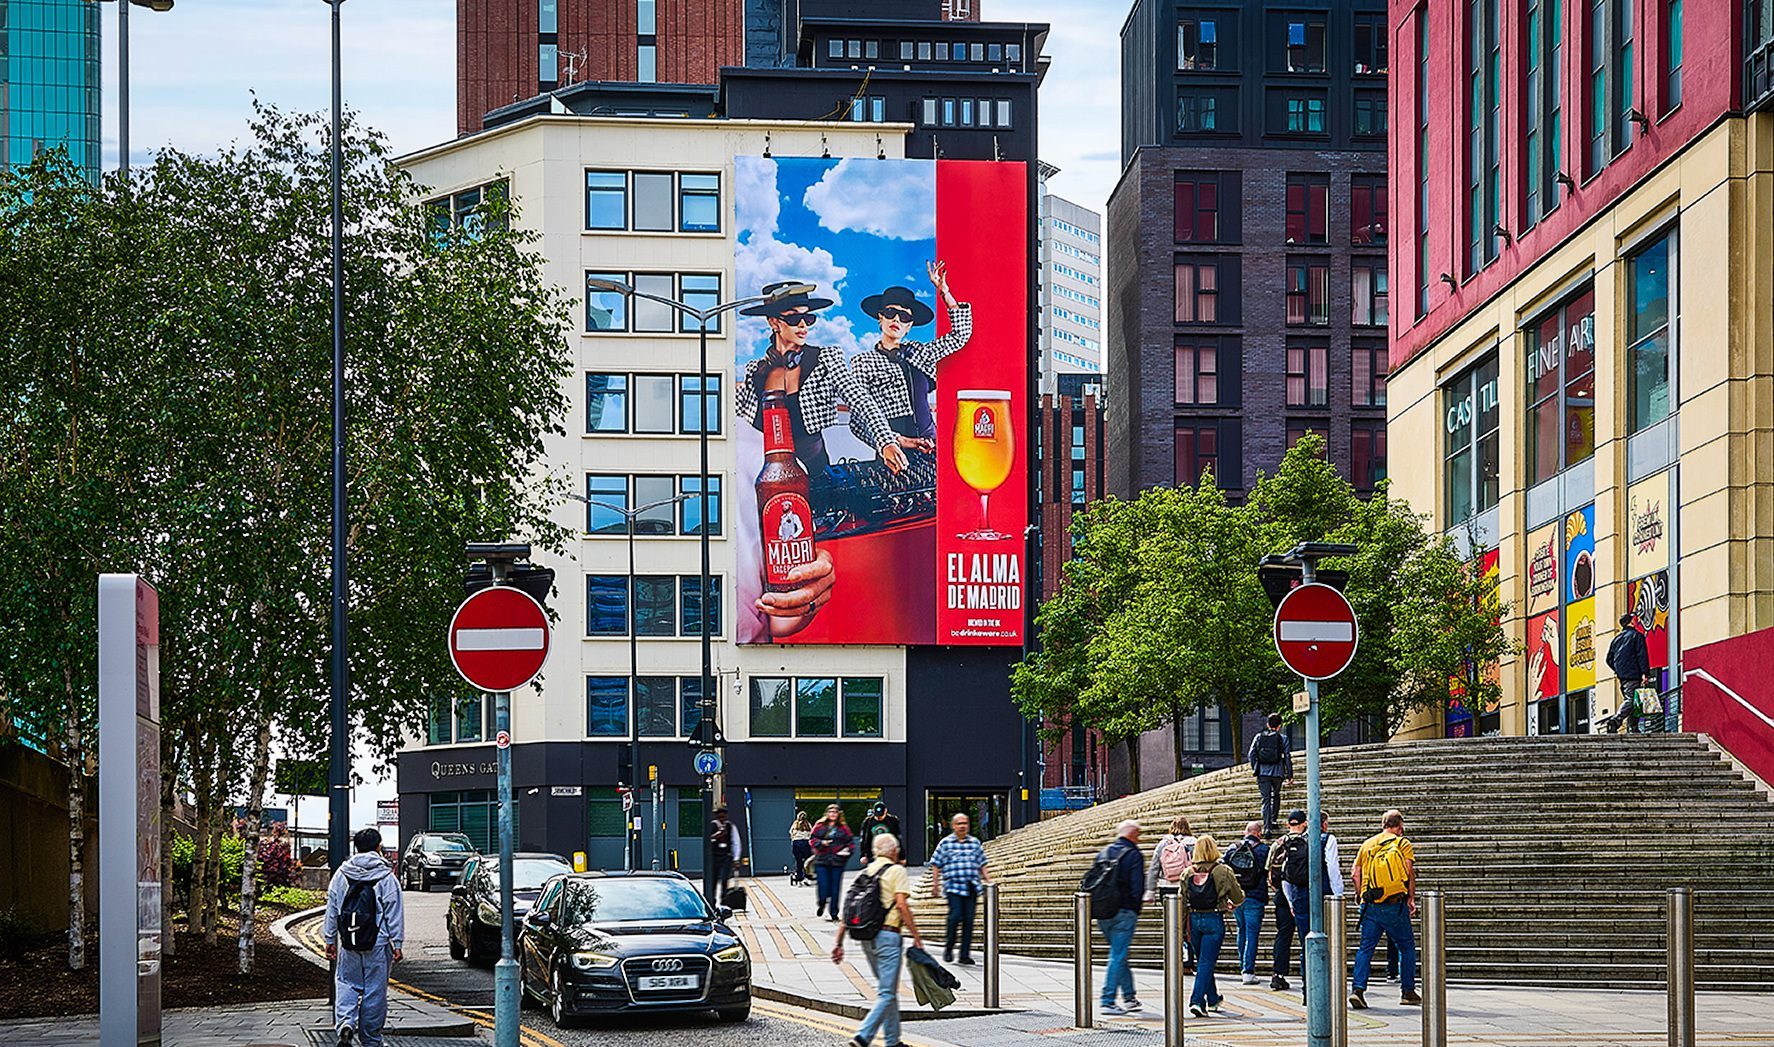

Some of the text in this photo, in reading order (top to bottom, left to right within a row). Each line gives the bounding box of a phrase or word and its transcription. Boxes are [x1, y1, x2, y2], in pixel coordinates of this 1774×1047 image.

[1447, 377, 1499, 434] CASTL
[1528, 335, 1559, 384] FINE
[947, 553, 1020, 583] EL ALMA
[947, 585, 1020, 610] DE MADRID
[479, 762, 498, 774] GAT
